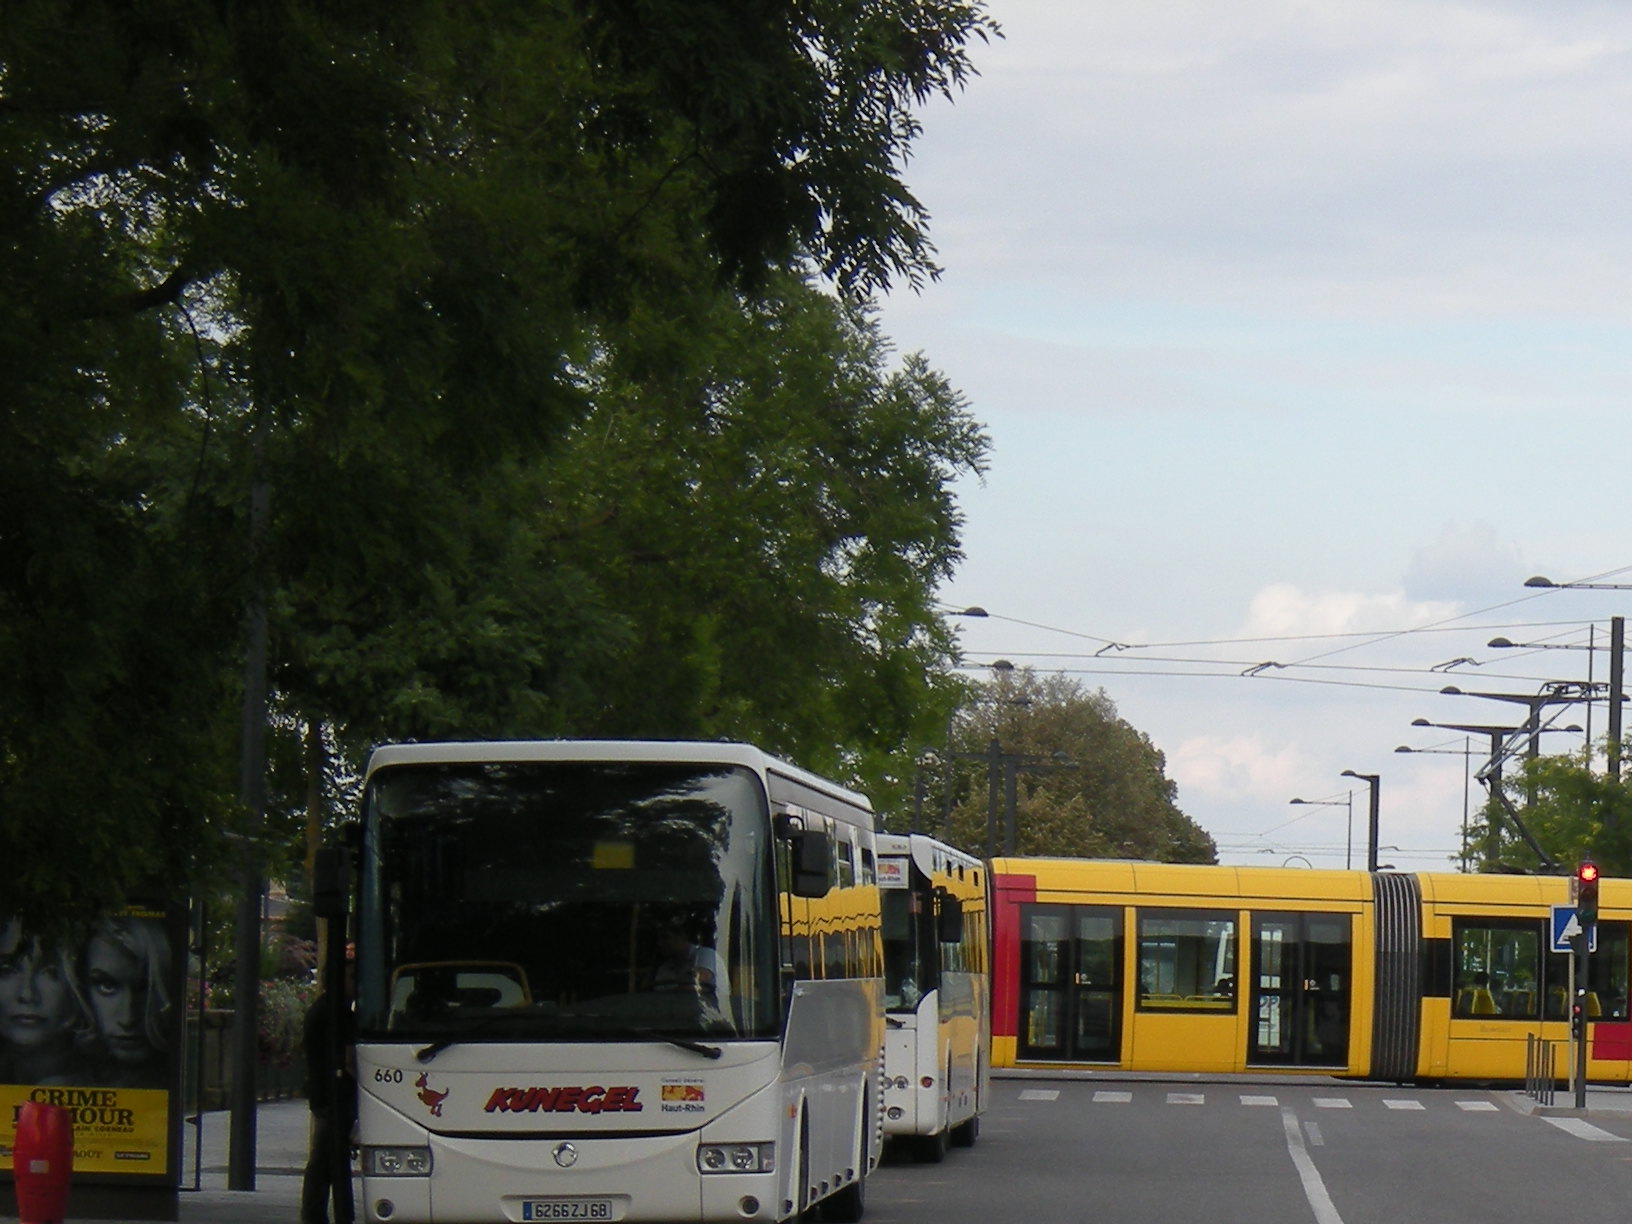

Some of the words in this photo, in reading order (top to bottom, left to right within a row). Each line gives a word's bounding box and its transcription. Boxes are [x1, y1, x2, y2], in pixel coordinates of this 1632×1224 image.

[374, 1069, 403, 1083] 660
[30, 1088, 117, 1107] CRIME
[484, 1086, 643, 1114] KUNEGEL
[536, 1204, 569, 1217] 6266
[571, 1204, 588, 1217] ZJ
[591, 1204, 607, 1217] 68
